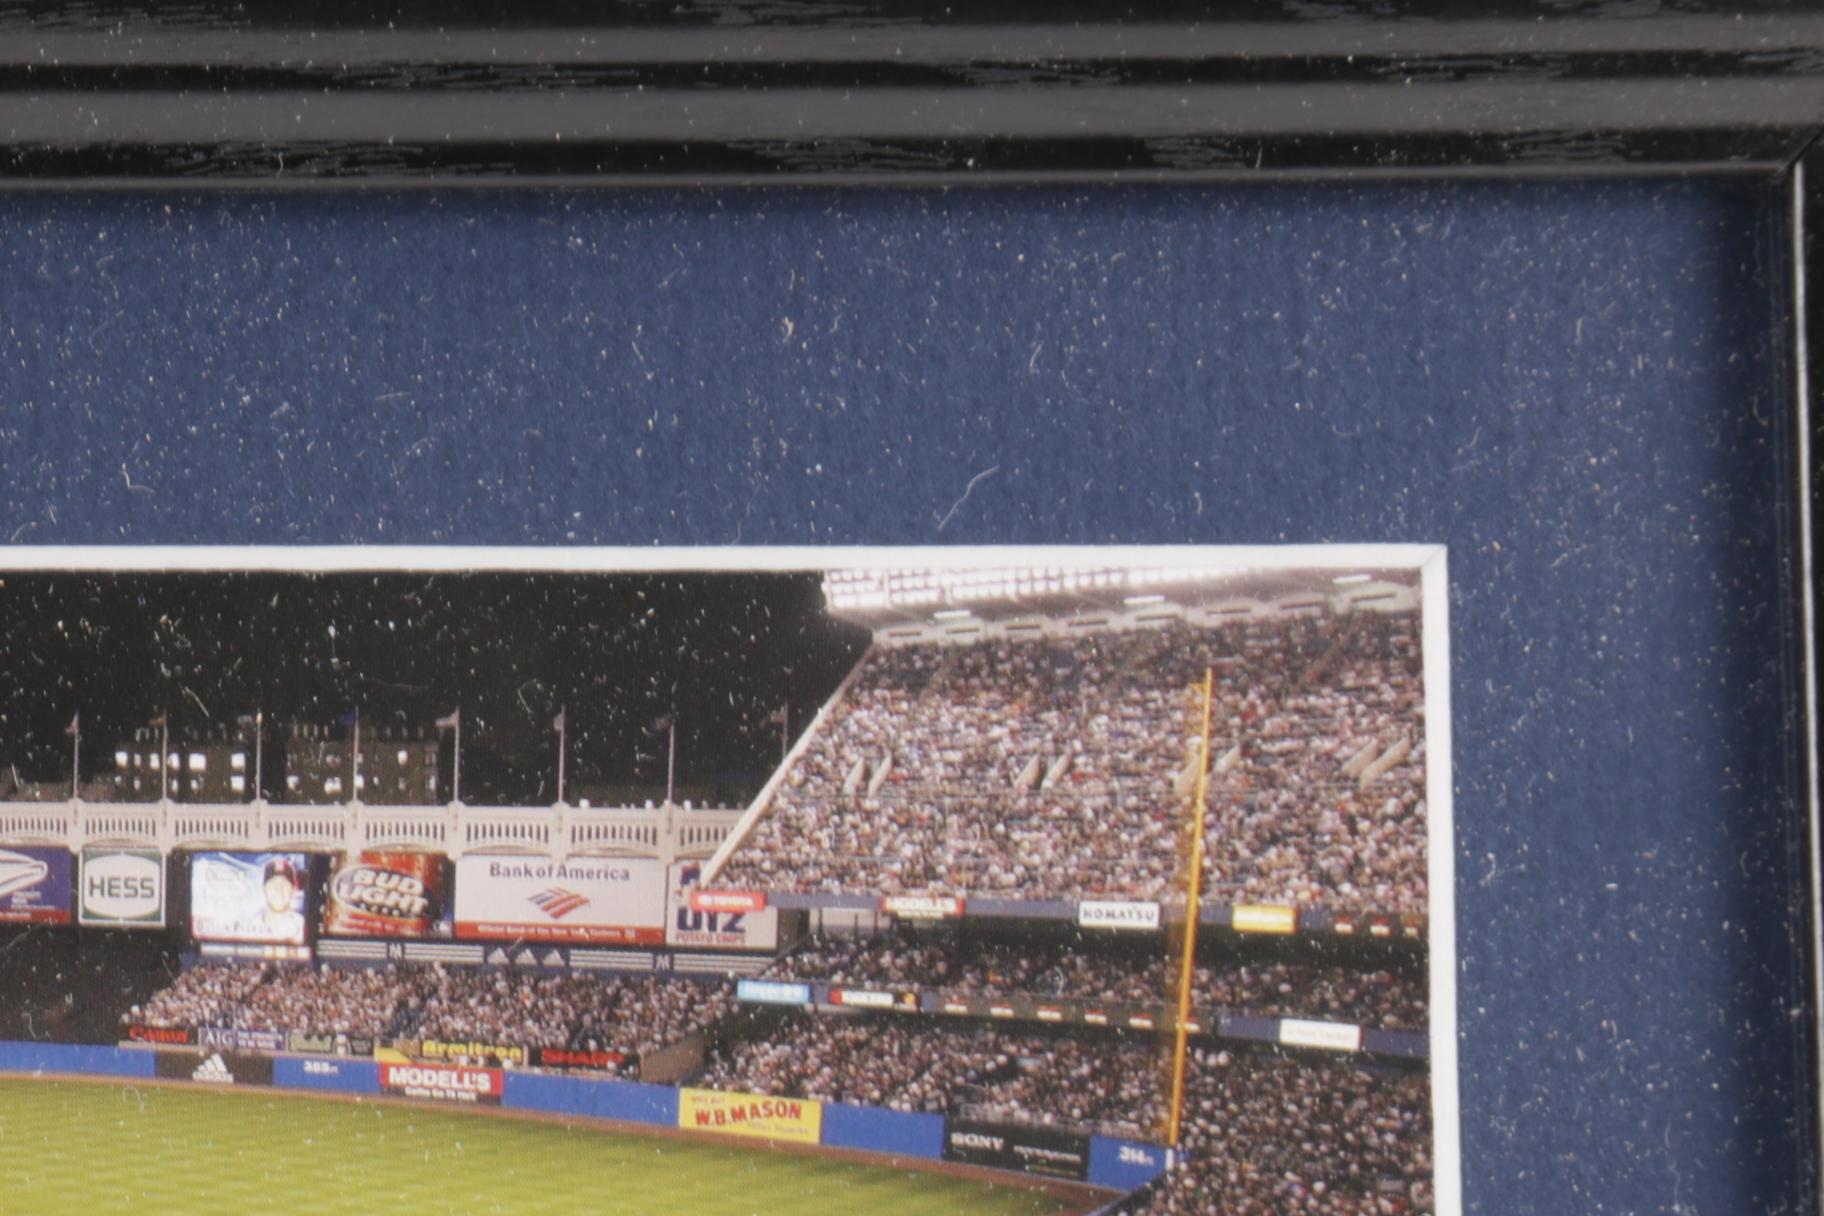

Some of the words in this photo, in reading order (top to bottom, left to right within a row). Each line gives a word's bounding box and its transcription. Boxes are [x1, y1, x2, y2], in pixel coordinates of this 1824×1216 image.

[353, 868, 423, 896] BUD
[490, 862, 533, 877] Bank
[536, 863, 553, 878] of
[557, 864, 630, 881] America
[89, 876, 155, 898] HESS
[338, 882, 429, 914] LIGHT
[1083, 907, 1156, 921] KOMATSU
[389, 1067, 491, 1092] MODELL'S
[951, 1132, 1004, 1150] SONY
